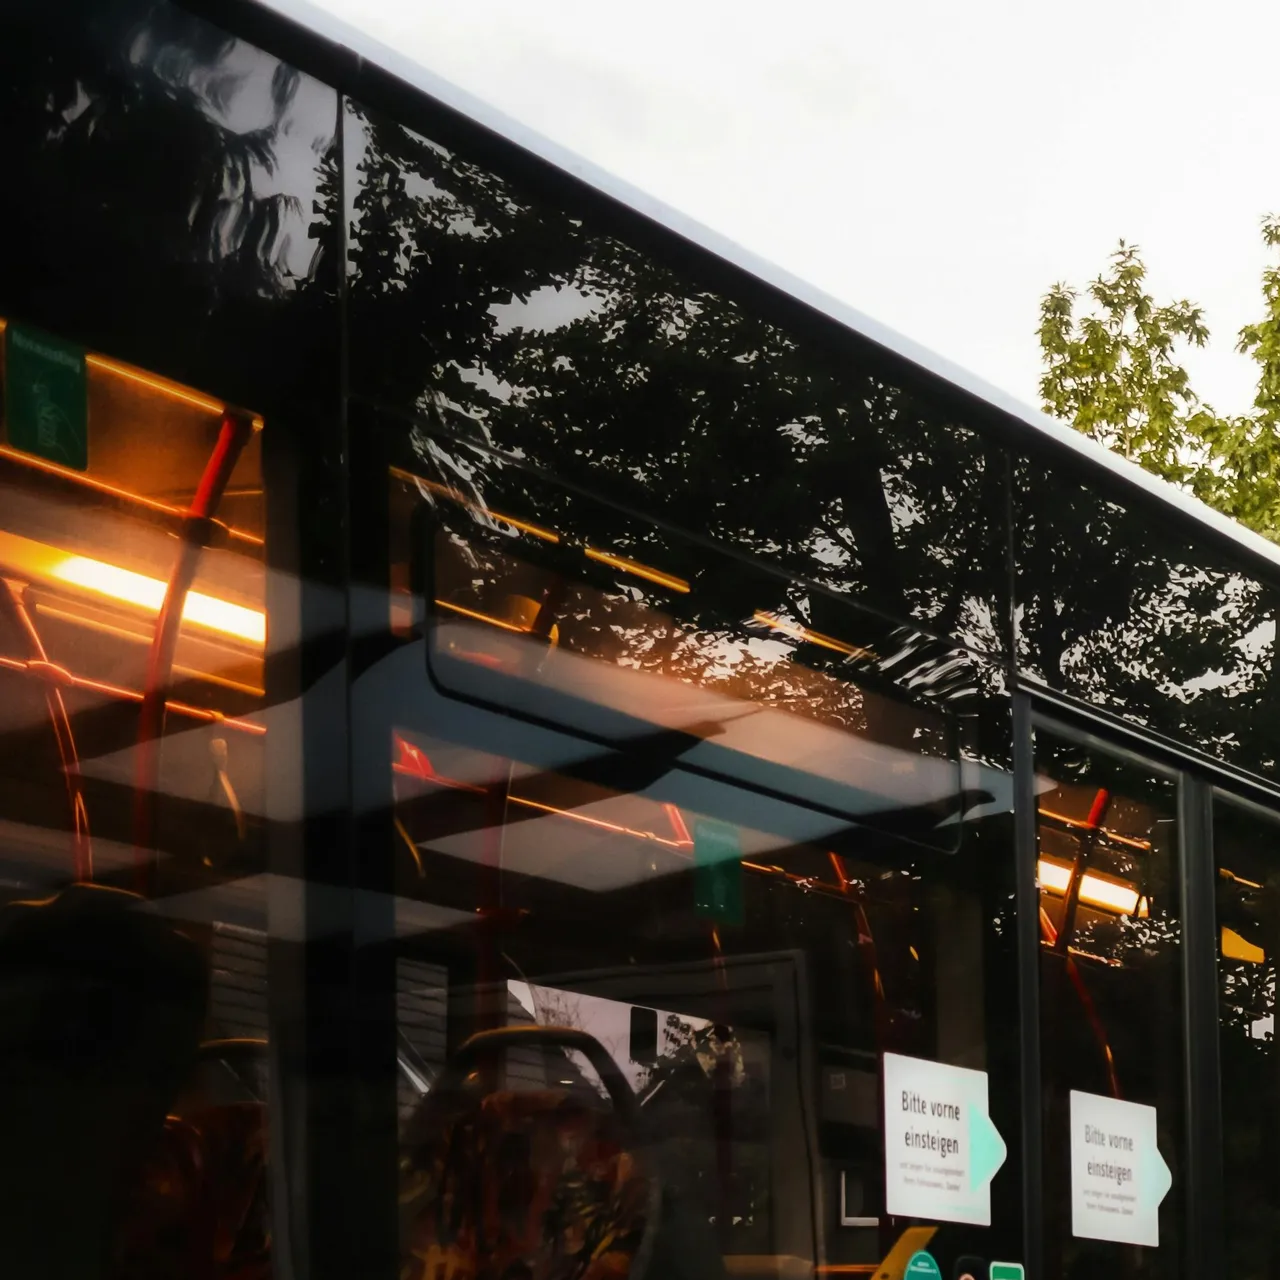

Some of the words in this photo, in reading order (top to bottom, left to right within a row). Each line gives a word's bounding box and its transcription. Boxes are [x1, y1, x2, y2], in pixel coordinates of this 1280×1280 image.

[901, 1090, 927, 1116] Bitte
[931, 1102, 961, 1121] vorne
[904, 1125, 959, 1158] einsteigen
[1084, 1124, 1106, 1147] Bitte
[1109, 1134, 1134, 1152] vorne
[1087, 1156, 1133, 1186] einsteigen
